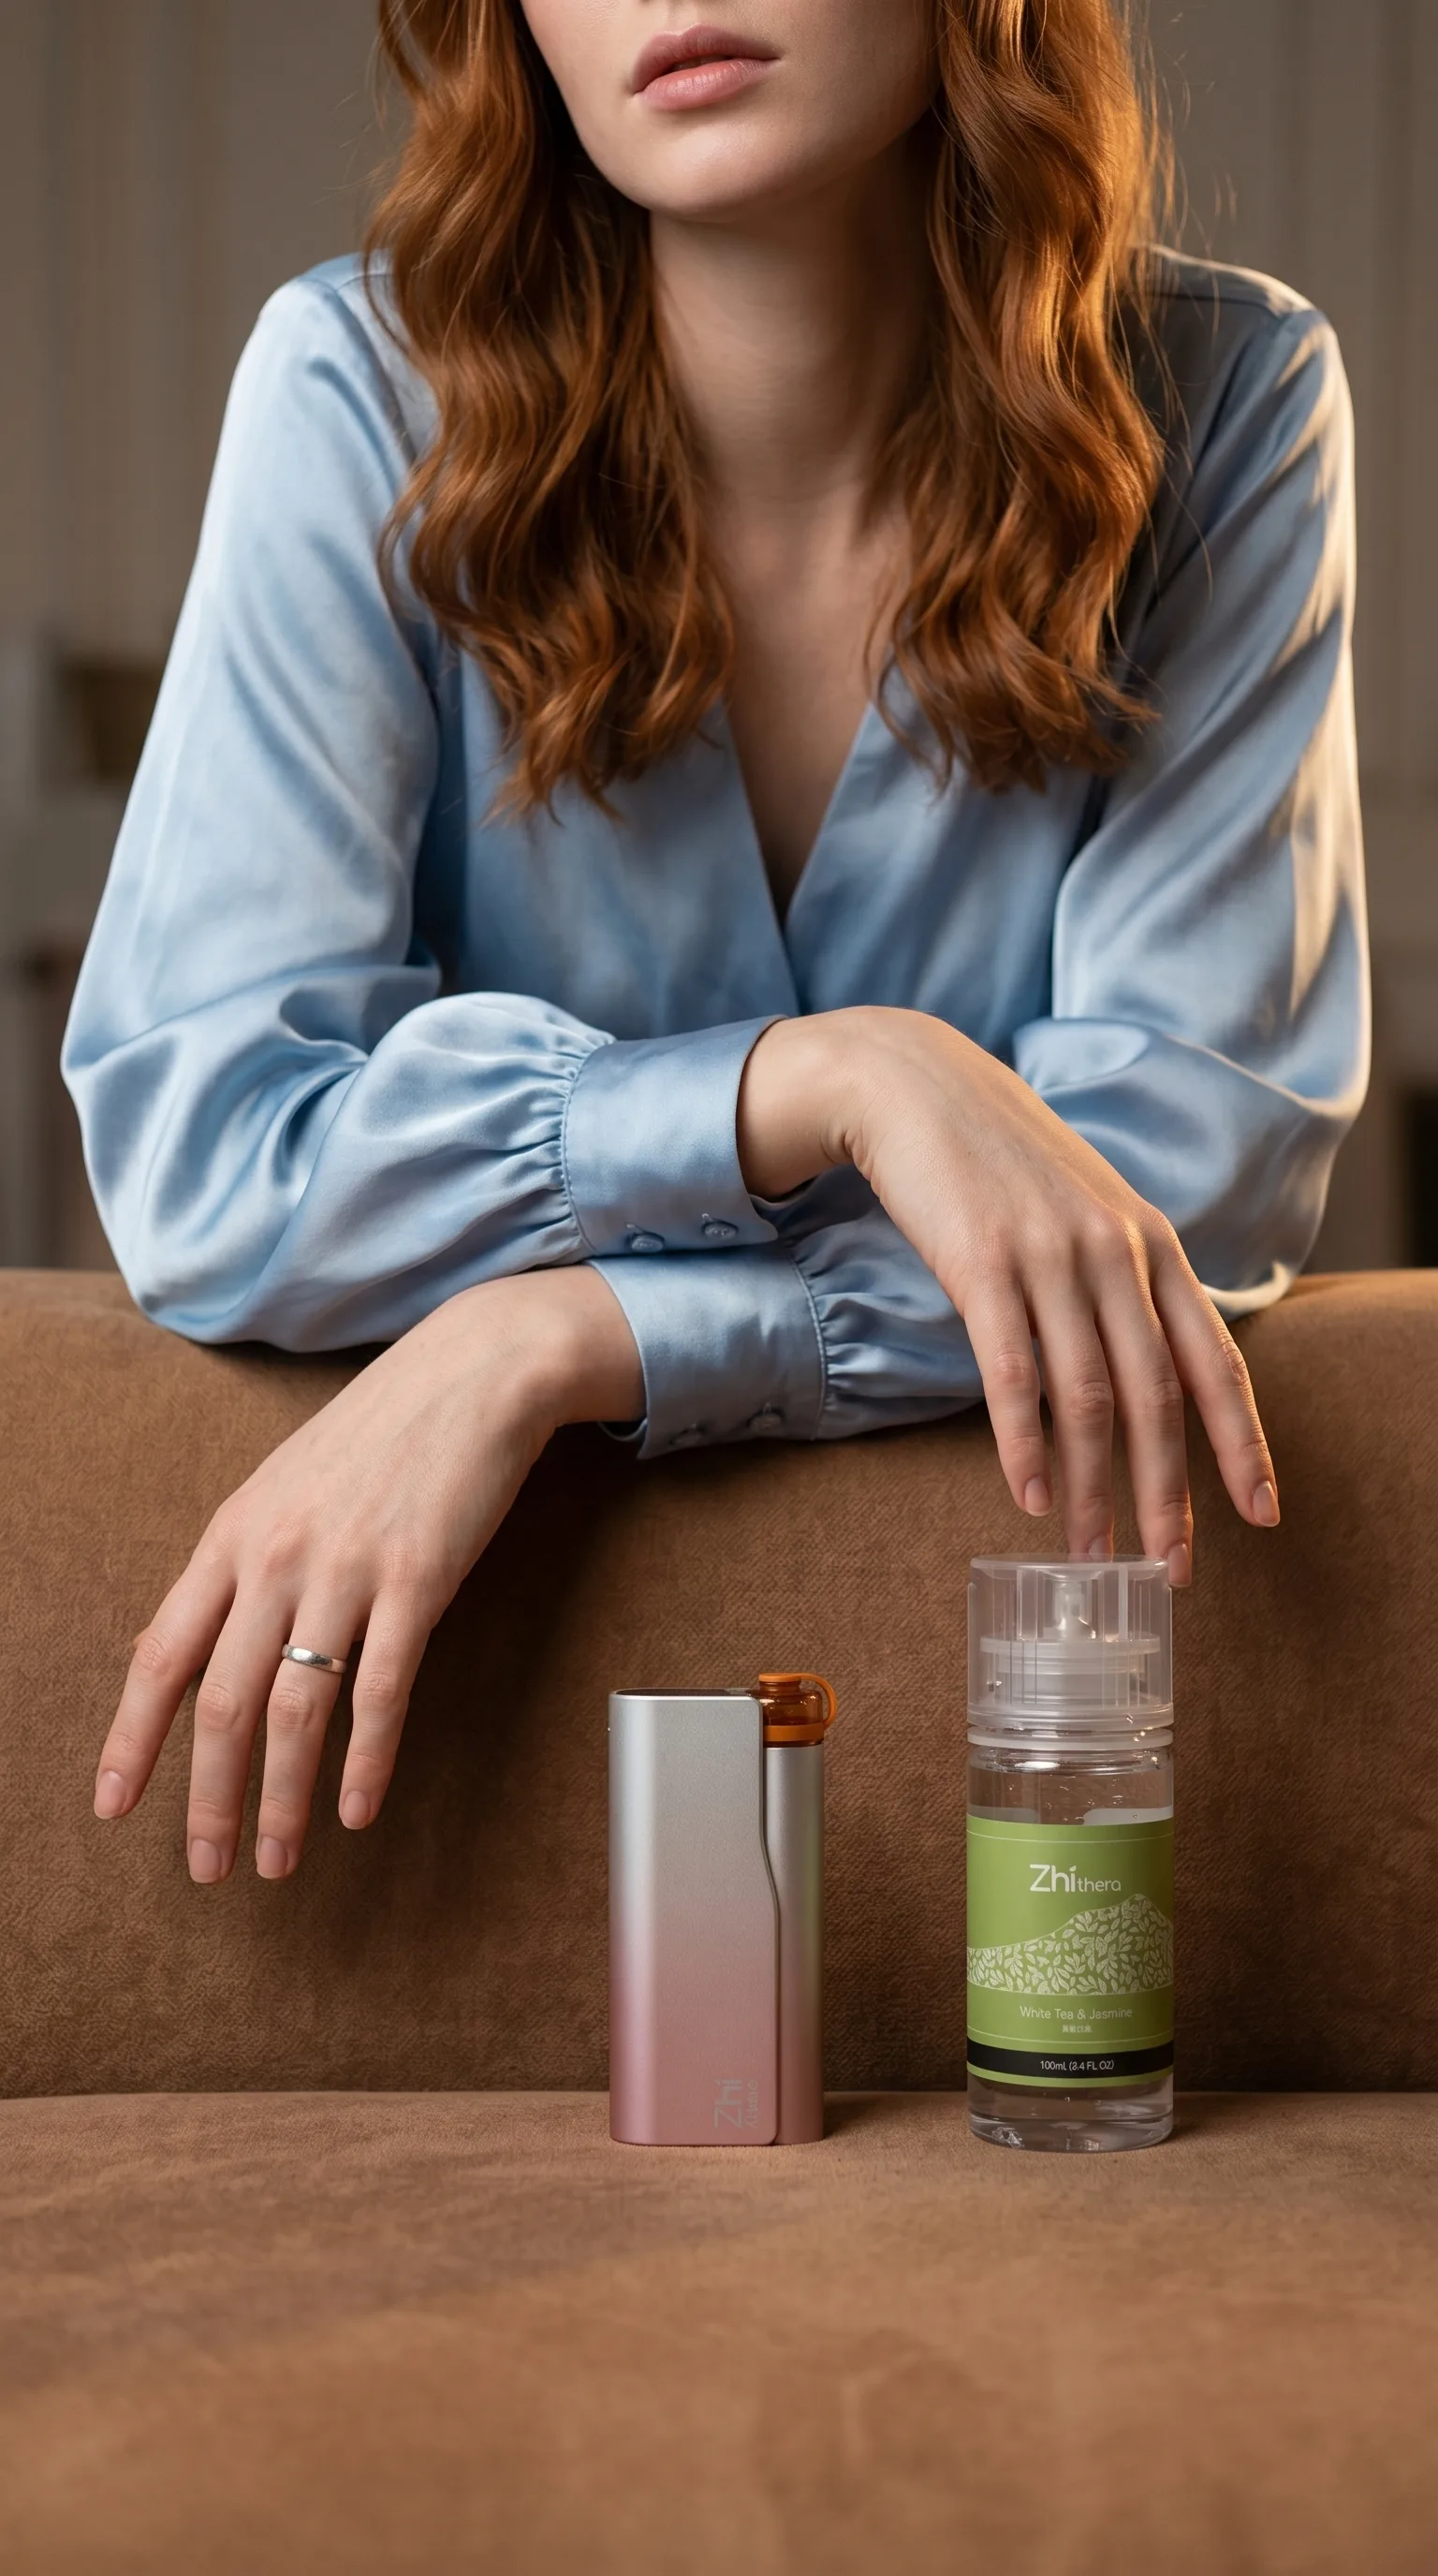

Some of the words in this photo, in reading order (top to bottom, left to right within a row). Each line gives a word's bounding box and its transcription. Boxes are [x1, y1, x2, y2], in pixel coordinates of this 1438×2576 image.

[1020, 2005, 1051, 2019] White
[1054, 2008, 1074, 2020] Tea
[1077, 2008, 1087, 2020] &
[1090, 2007, 1133, 2020] Jasmine
[1040, 2060, 1067, 2071] 100mL
[1087, 2060, 1098, 2071] FL
